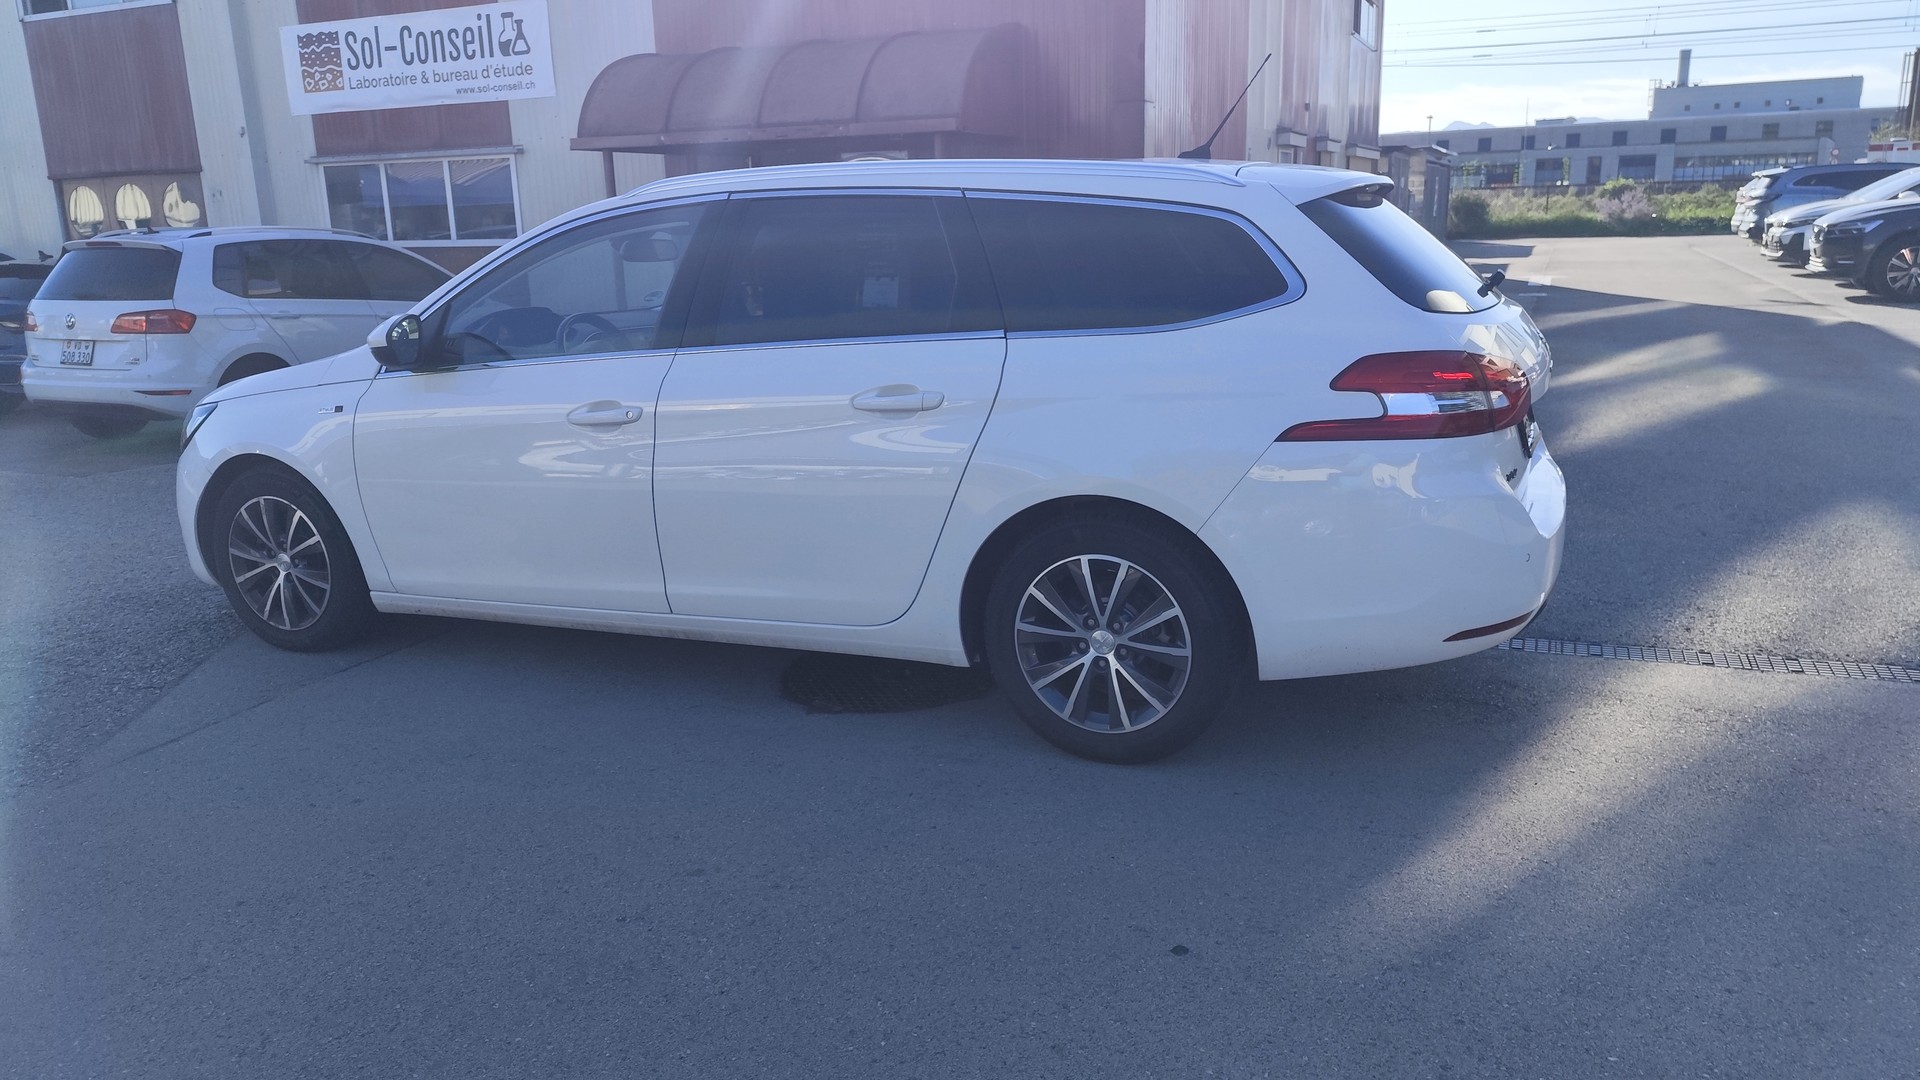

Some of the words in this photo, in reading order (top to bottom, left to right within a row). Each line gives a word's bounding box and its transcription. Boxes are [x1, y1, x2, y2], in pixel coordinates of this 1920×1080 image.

[345, 13, 494, 70] Sol-Conseil
[348, 72, 417, 90] Laboratoire
[421, 70, 430, 84] &
[433, 69, 478, 83] bureau
[481, 61, 534, 79] d'étude
[455, 80, 536, 95] www.sol-conseil.ch
[62, 350, 75, 362] 508
